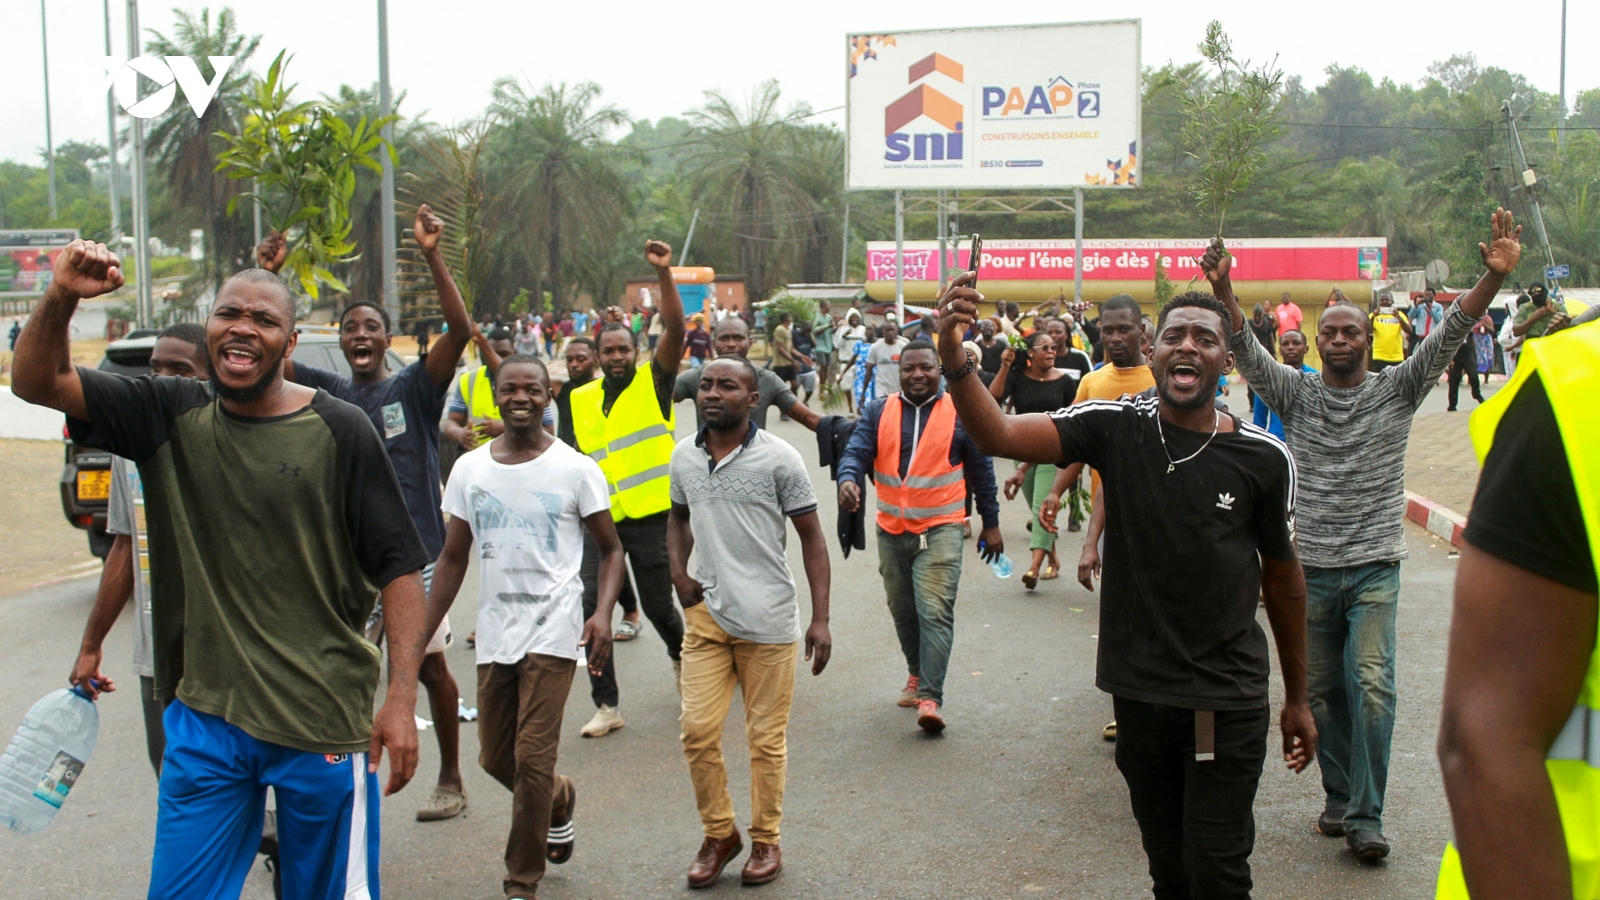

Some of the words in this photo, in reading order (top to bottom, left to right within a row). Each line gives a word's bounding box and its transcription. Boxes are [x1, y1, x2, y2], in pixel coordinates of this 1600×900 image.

[1077, 82, 1101, 90] Phase
[982, 85, 1074, 116] PAAP
[1079, 92, 1099, 118] 2
[883, 121, 964, 162] sni
[981, 132, 1051, 142] CONSTRUISONS
[1051, 131, 1100, 140] ENSEMBLE
[980, 253, 1026, 269] Pour
[1029, 251, 1112, 272] l'énegie
[1115, 251, 1150, 269] dès
